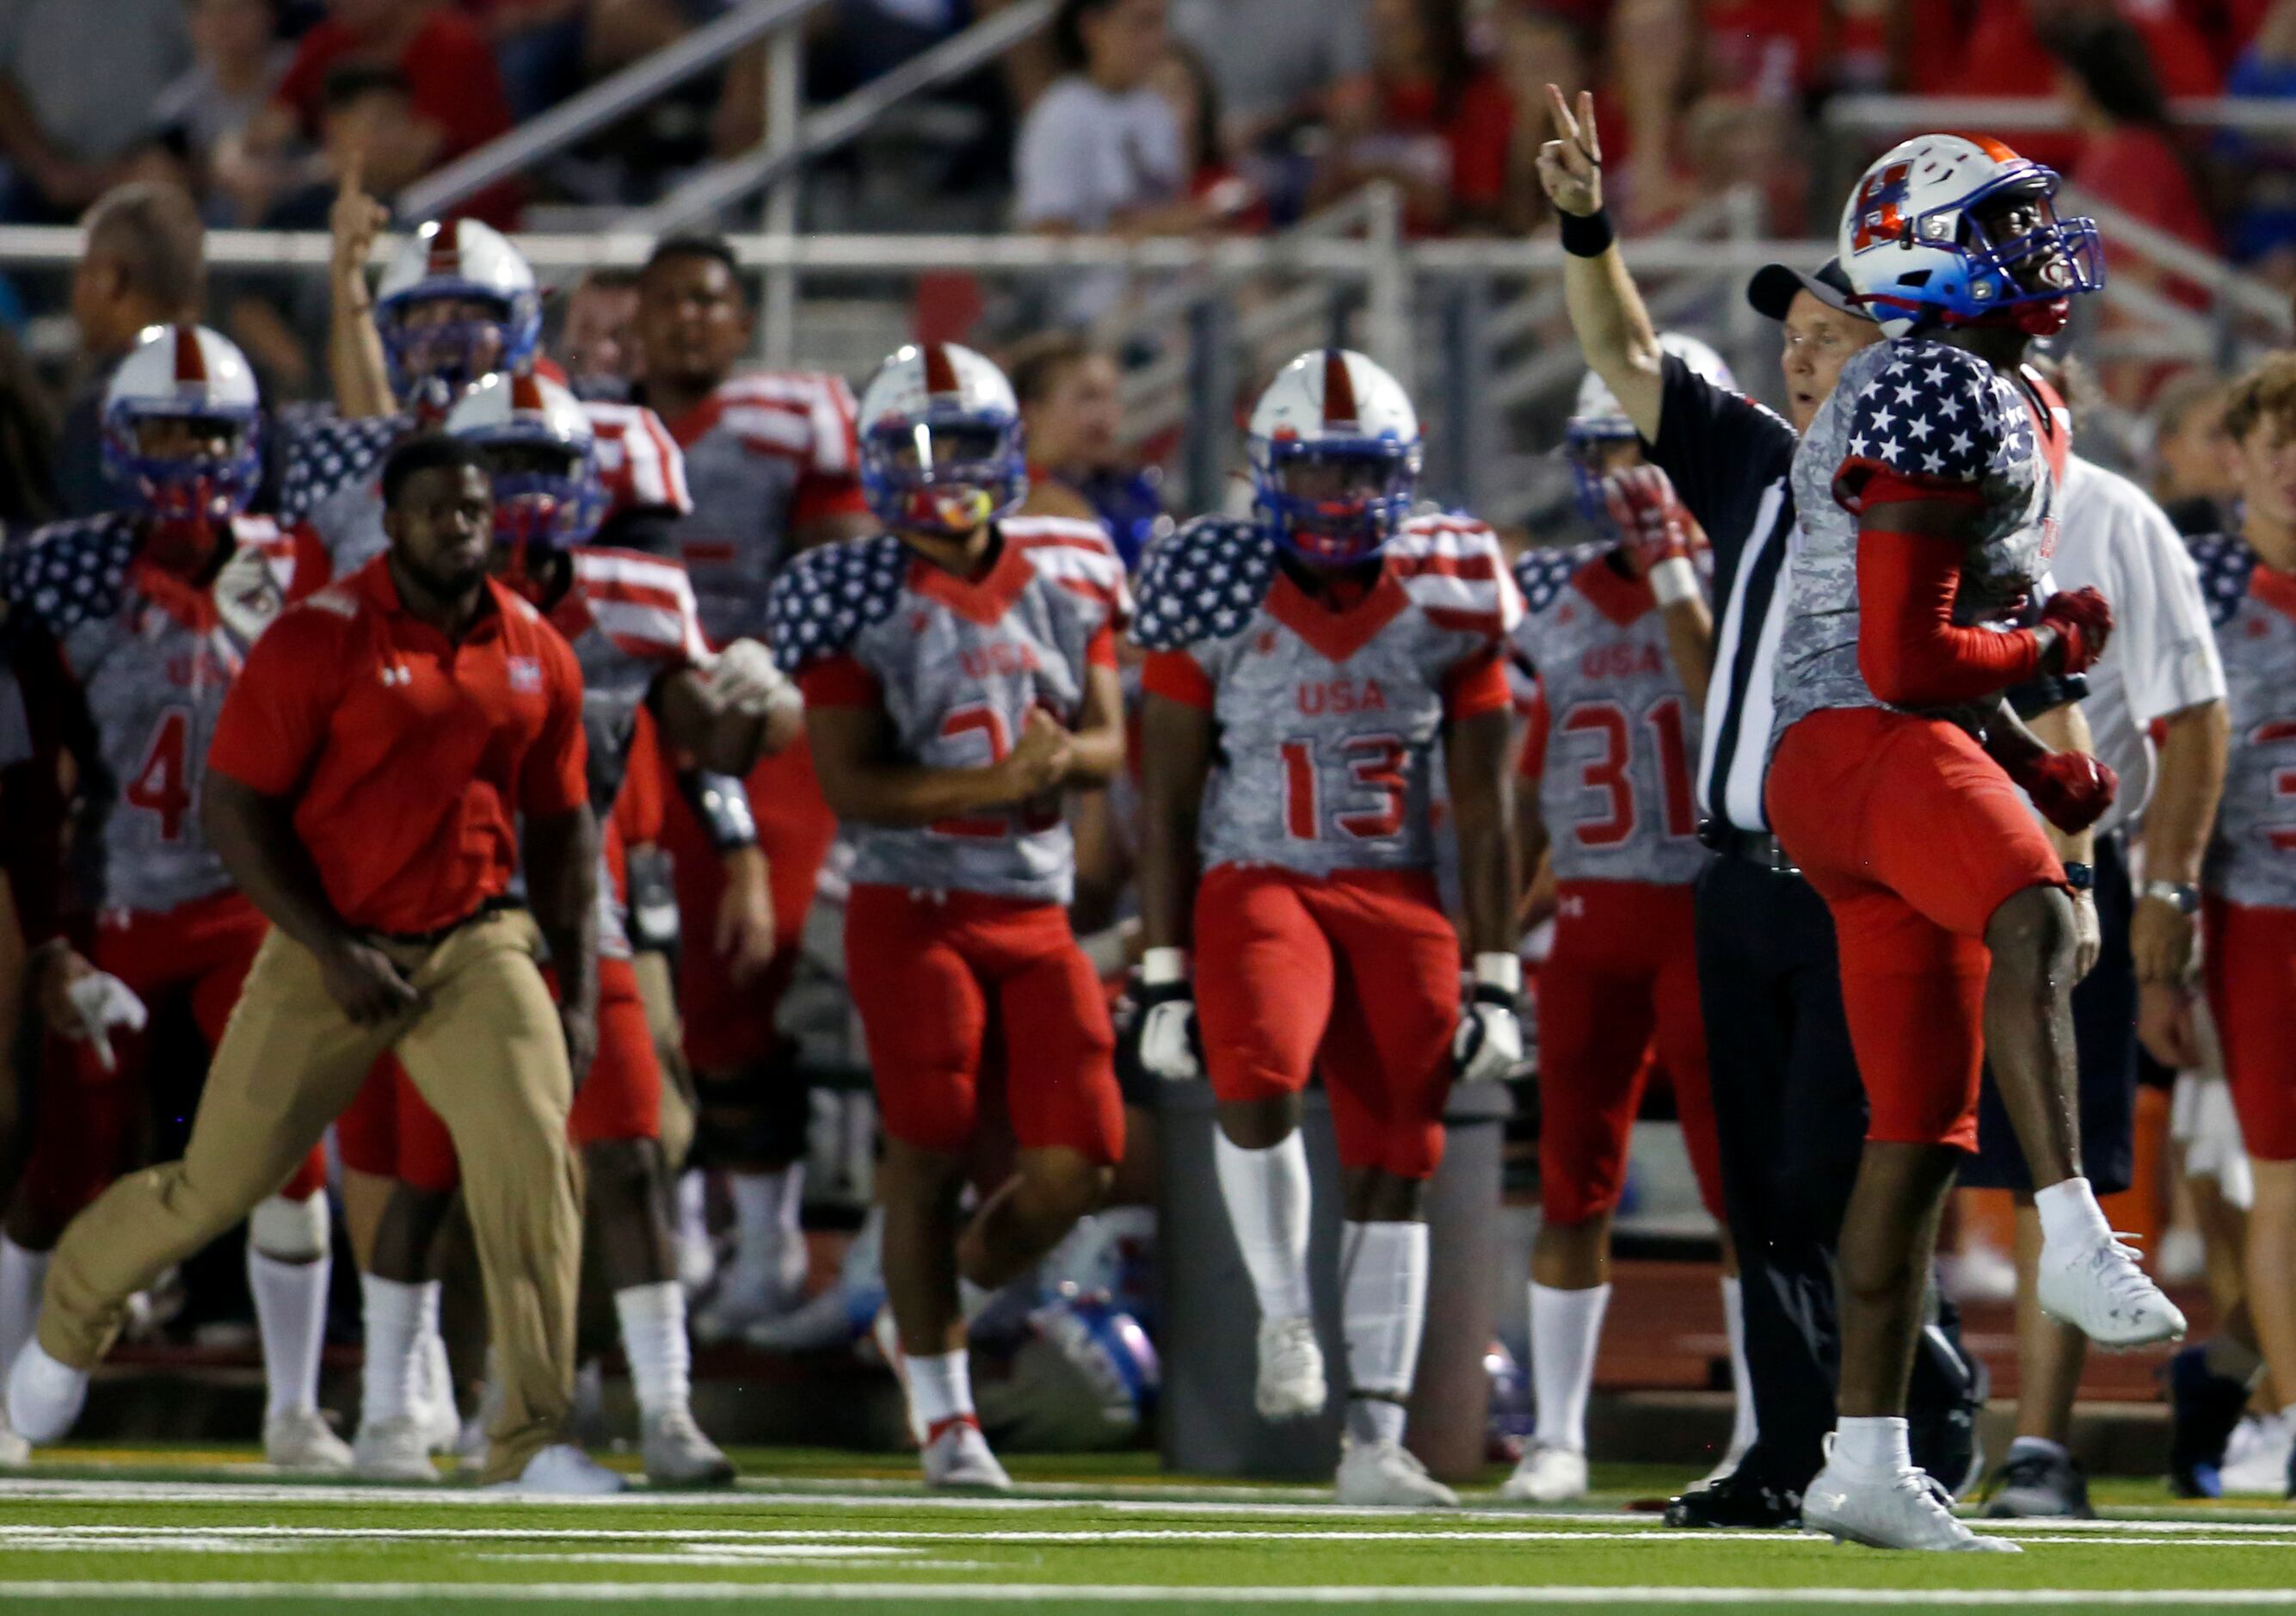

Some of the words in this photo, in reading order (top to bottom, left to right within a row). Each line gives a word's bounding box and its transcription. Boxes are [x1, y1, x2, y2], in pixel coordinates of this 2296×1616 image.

[1297, 678, 1387, 716] USA
[1582, 642, 1664, 679] USA
[124, 706, 198, 841] 4
[1280, 734, 1411, 842] 13
[1561, 696, 1696, 849] 31
